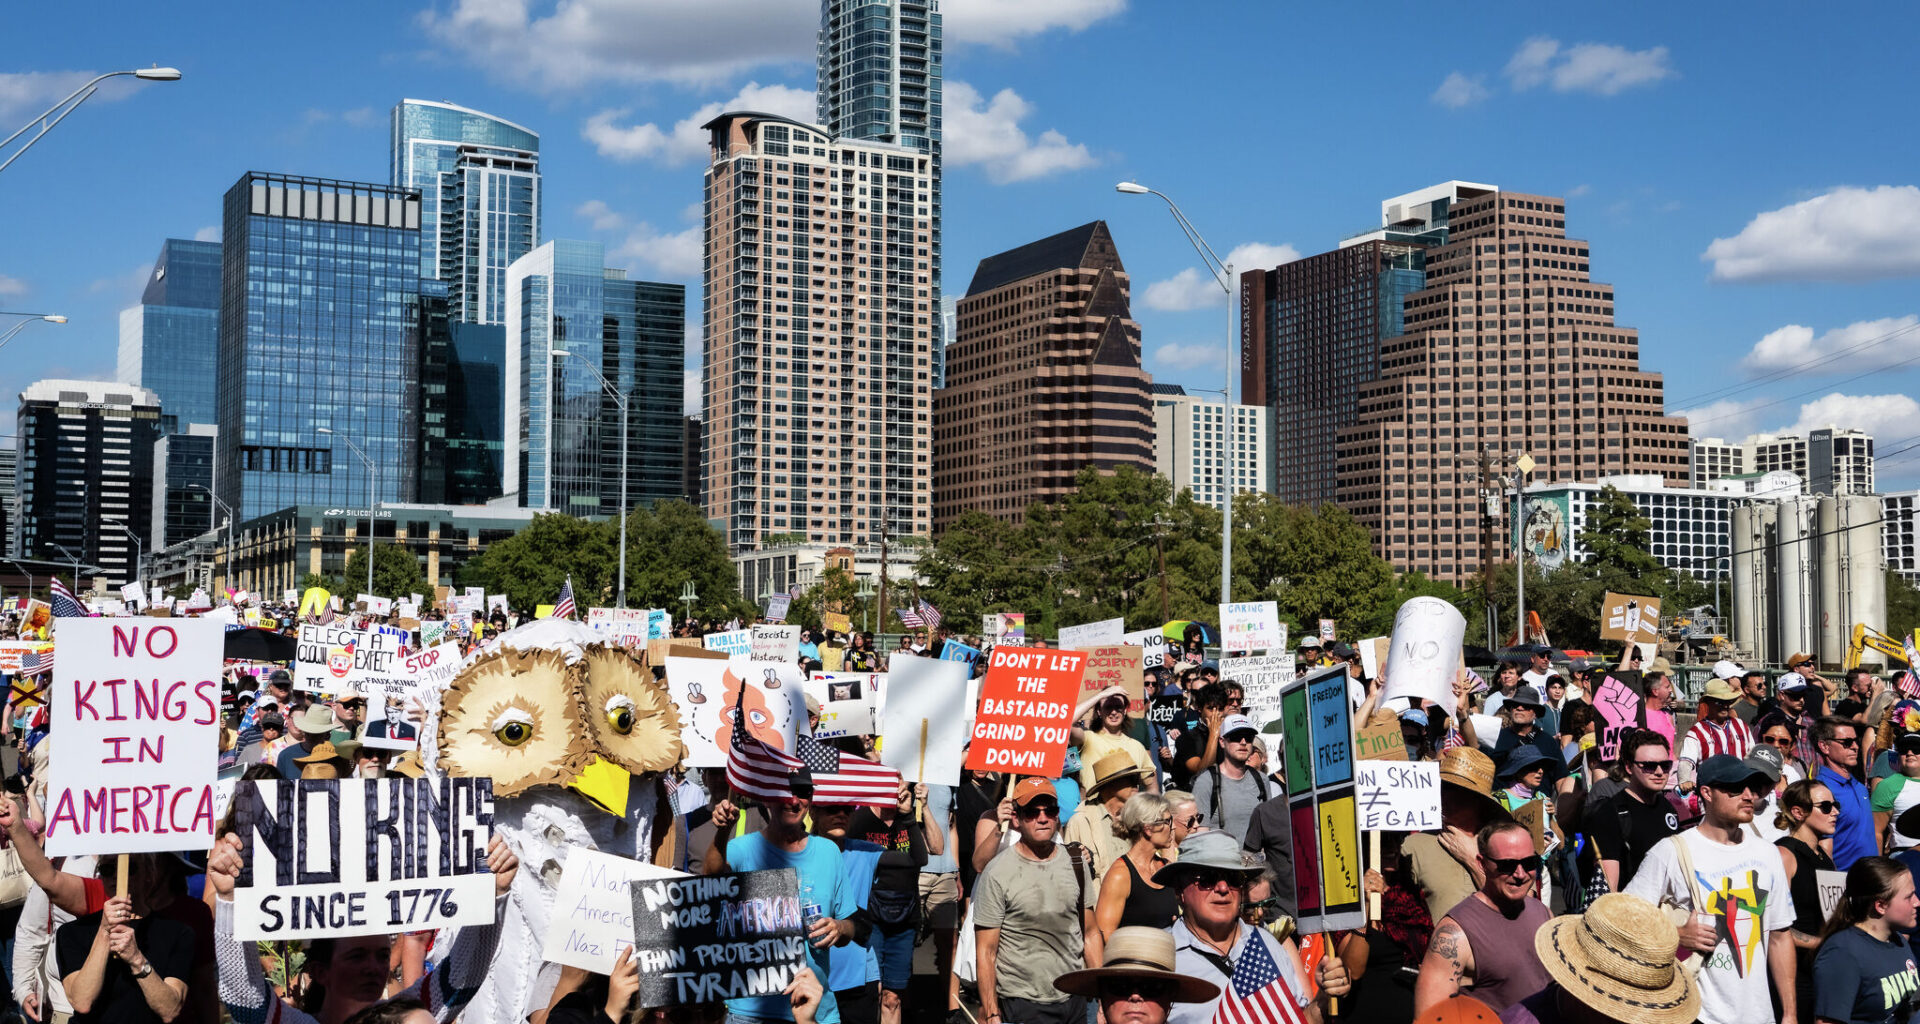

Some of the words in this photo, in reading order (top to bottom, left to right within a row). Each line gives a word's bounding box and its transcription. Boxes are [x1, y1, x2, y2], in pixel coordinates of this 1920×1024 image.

[1243, 352, 1250, 371] JW
[1811, 434, 1830, 442] Hilton
[375, 510, 392, 518] LABS
[1228, 604, 1264, 614] CARING
[421, 622, 433, 634] NO
[1228, 622, 1265, 633] PEOPLE
[1823, 612, 1829, 628] 2
[113, 625, 179, 659] NO
[303, 626, 363, 648] ELECT
[371, 634, 383, 649] A
[422, 625, 444, 645] KINGS
[709, 633, 746, 648] PUBLIC
[752, 626, 791, 640] Fascists
[1144, 635, 1163, 648] NO
[1095, 647, 1122, 656] OUR
[1227, 640, 1273, 649] POLITICAL
[1402, 640, 1440, 661] NO
[1877, 642, 1902, 655] KOMATSU
[406, 649, 440, 674] STOP
[994, 652, 1046, 670] DON'T
[1050, 655, 1081, 672] LET
[1086, 658, 1139, 669] OCIETY
[1221, 659, 1247, 669] MAGA
[1249, 658, 1265, 666] AND
[306, 677, 325, 689] THE
[365, 676, 418, 688] FAUX-KING
[1097, 670, 1122, 679] WAS
[384, 685, 405, 694] JOKE
[1017, 677, 1048, 693] THE
[1245, 685, 1270, 693] ETTER
[1312, 683, 1343, 705] FREEDOM
[74, 679, 217, 726] KINGS
[983, 698, 1069, 719] BASTARDS
[975, 723, 1026, 741] GRIND
[1034, 726, 1068, 744] YOU
[101, 735, 165, 764] IN
[985, 748, 1046, 768] DOWN!
[1319, 741, 1345, 770] FREE
[46, 784, 215, 838] AMERICA
[235, 779, 341, 888] NO
[365, 777, 495, 883] KINGS
[1326, 814, 1358, 899] RESIST
[581, 860, 631, 896] Mak
[642, 876, 740, 912] NOTHING
[260, 891, 367, 933] SINCE
[385, 887, 459, 926] 1776
[571, 894, 632, 928] Americ
[716, 896, 803, 938] AMERICAN
[564, 929, 603, 956] Nazi
[636, 947, 687, 974] THAN
[692, 936, 805, 968] PROTESTING
[662, 961, 808, 1004] TYRANNY
[1880, 967, 1920, 1010] NIK
